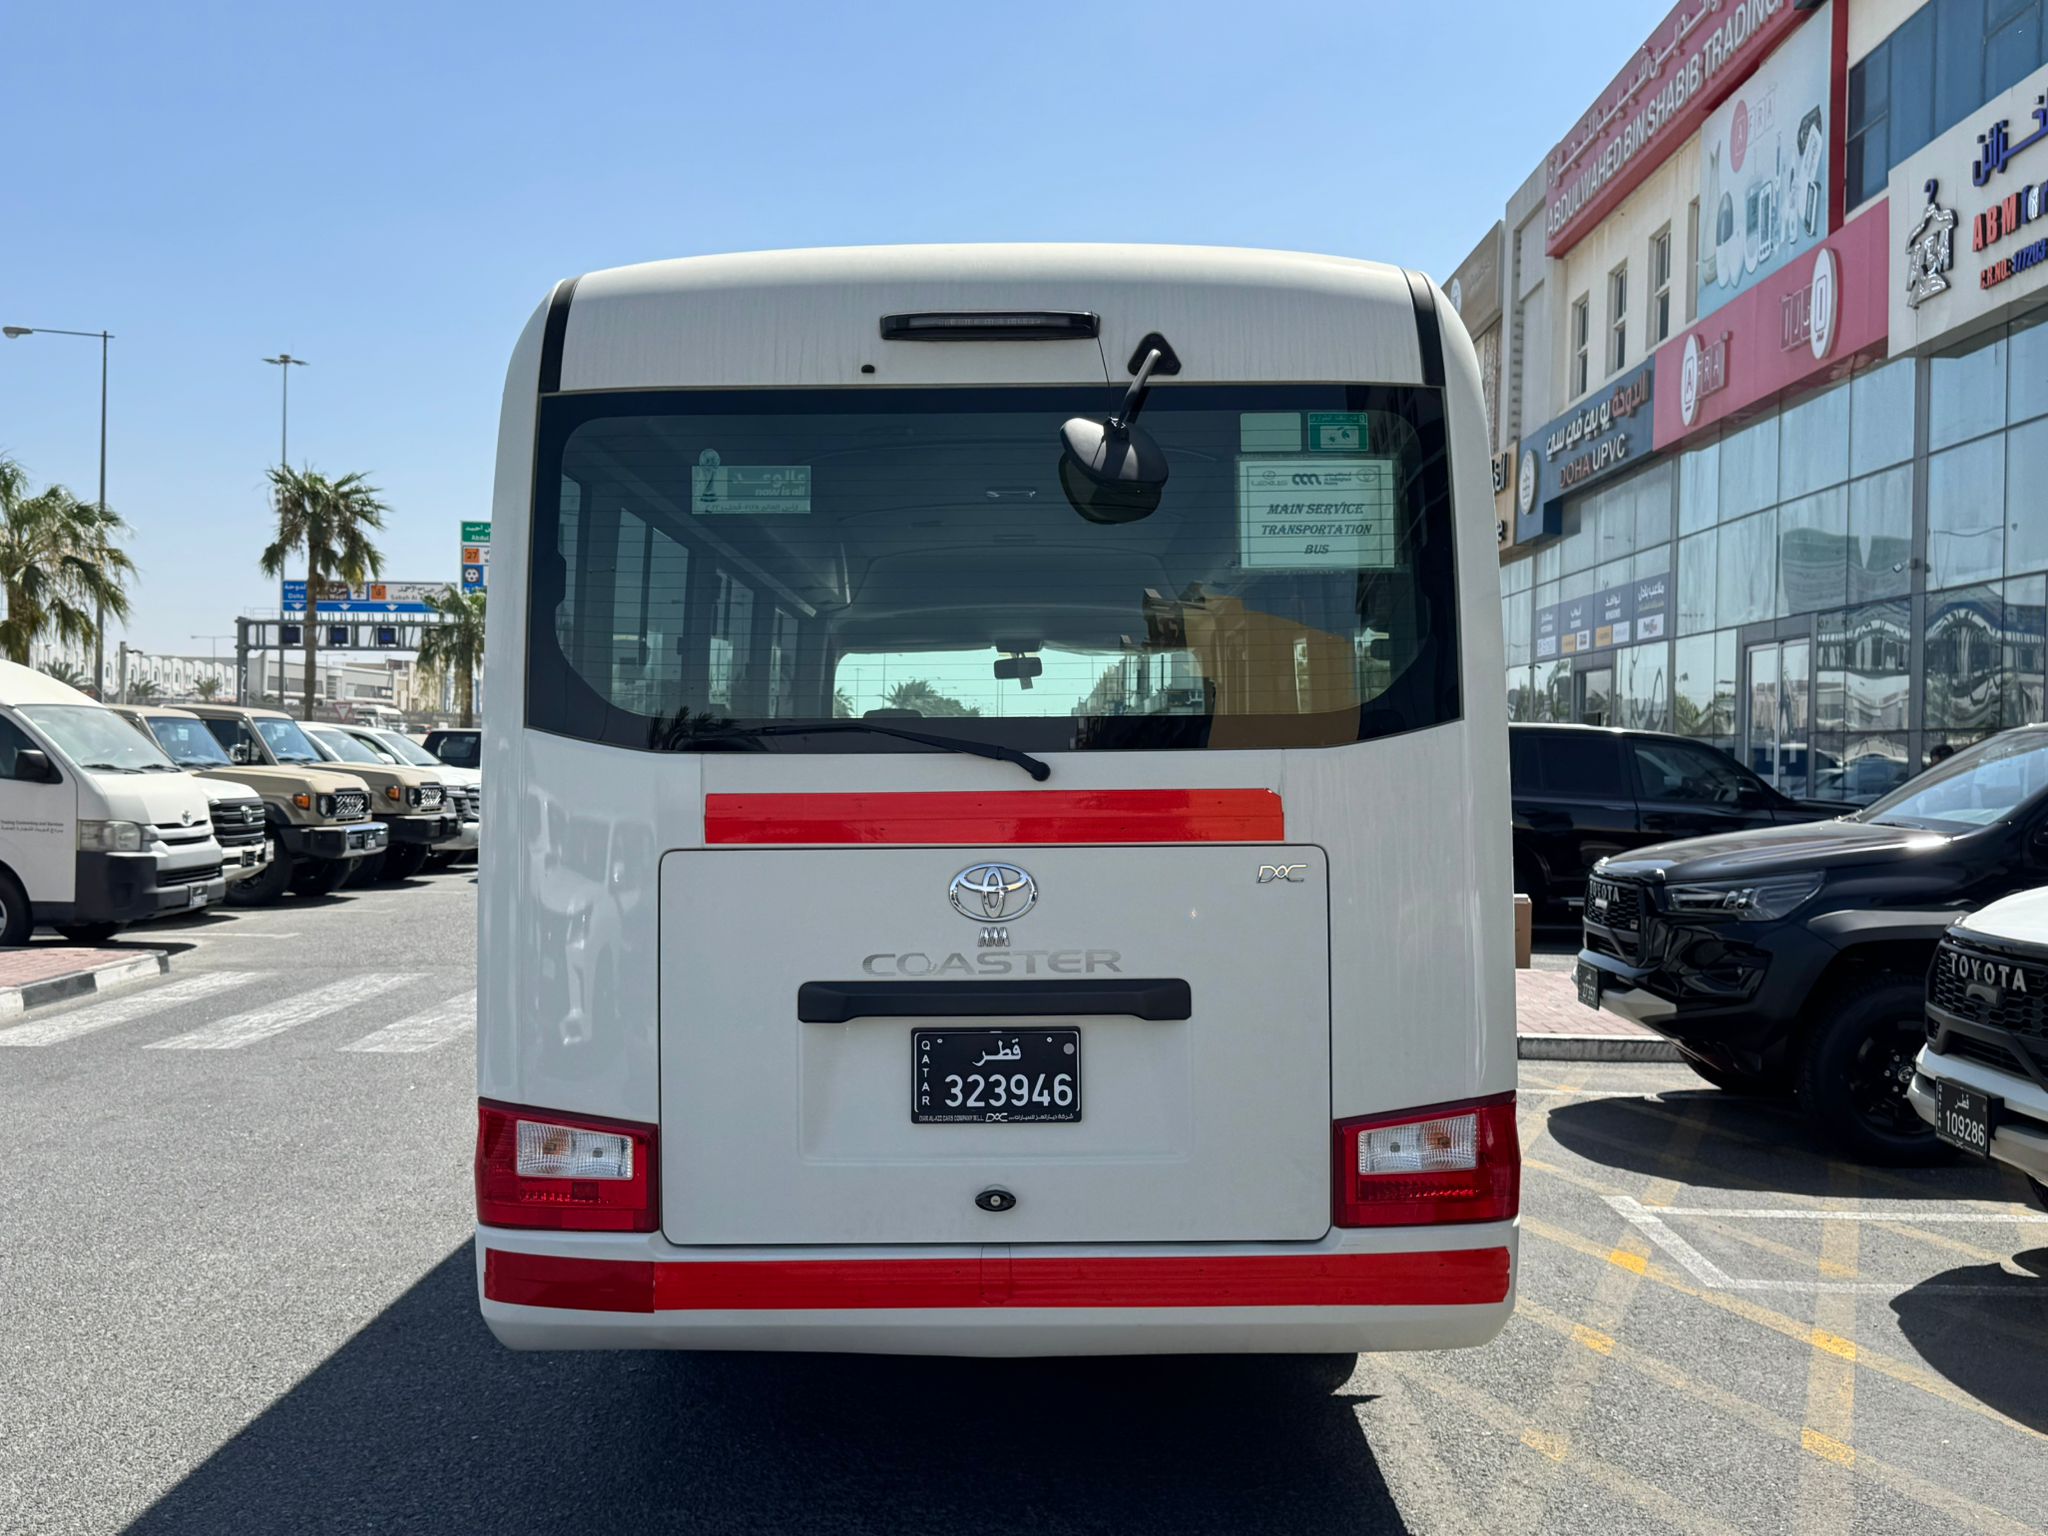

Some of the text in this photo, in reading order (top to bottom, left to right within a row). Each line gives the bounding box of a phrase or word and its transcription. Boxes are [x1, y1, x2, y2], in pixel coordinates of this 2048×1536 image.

[1548, 137, 1624, 235] ABDULWAHED
[1623, 108, 1646, 160] BIN
[1647, 53, 1701, 136] SHABIB
[1972, 192, 2018, 253] ABM
[1611, 370, 1650, 418] الدوحة
[1559, 454, 1592, 488] DOHA
[1592, 433, 1626, 471] UPVC
[755, 487, 779, 497] now
[792, 486, 806, 497] all
[1266, 502, 1366, 516] MAIN SERVICE
[1261, 524, 1373, 536] TRANSPORTATION
[1303, 544, 1330, 555] BUS
[1589, 880, 1620, 903] TOYOTA
[862, 949, 1124, 978] COASTER
[1949, 952, 2028, 993] TOYOTA
[971, 1037, 1023, 1067] قطر
[920, 1040, 931, 1106] QATAR
[944, 1073, 1074, 1108] 323946
[1945, 1109, 1986, 1148] 109286
